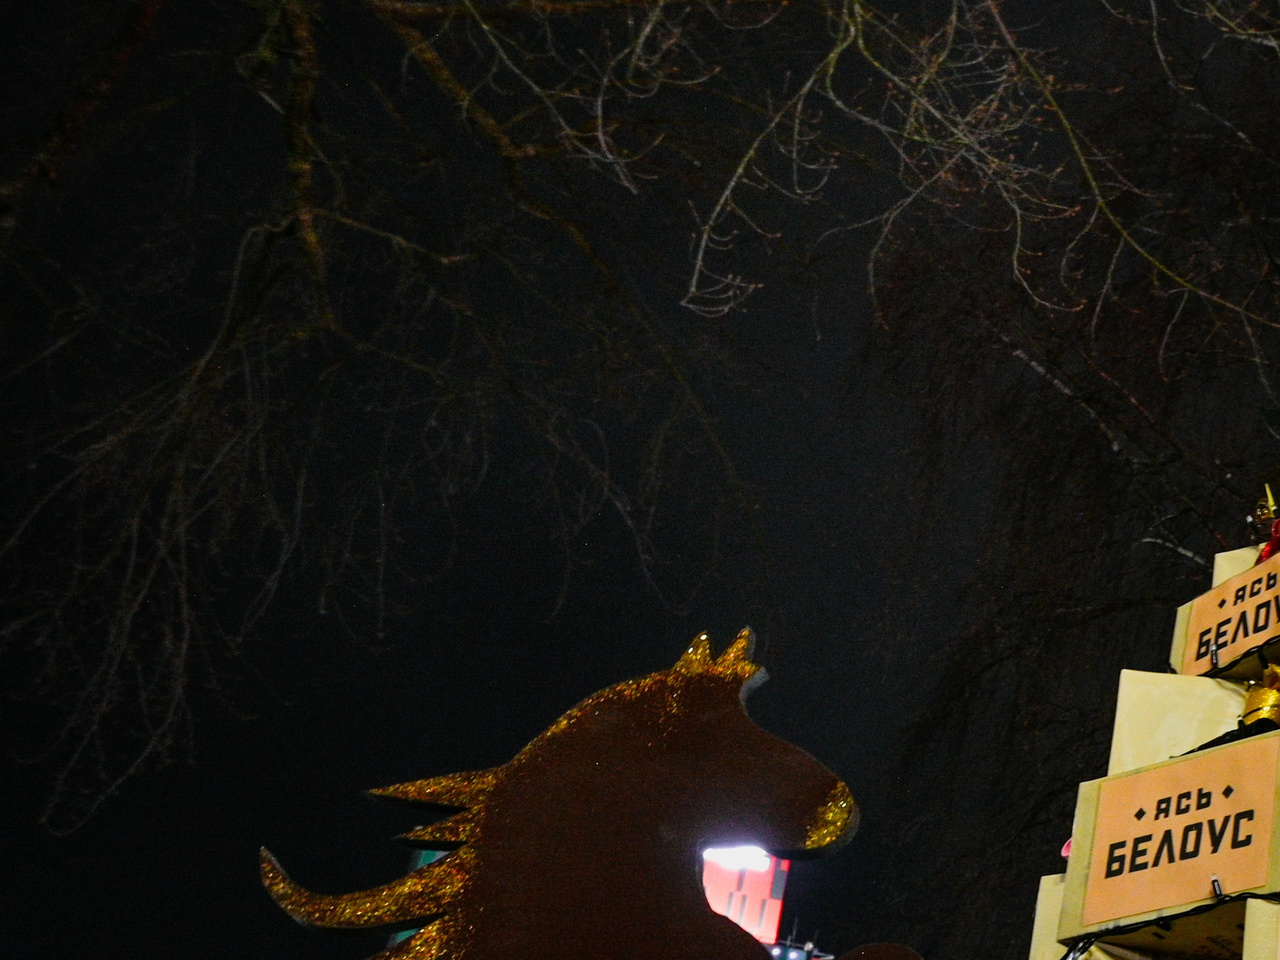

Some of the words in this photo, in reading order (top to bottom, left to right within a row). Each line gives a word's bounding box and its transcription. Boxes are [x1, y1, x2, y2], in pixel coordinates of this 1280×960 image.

[1232, 571, 1278, 606] ЯСЬ
[1154, 788, 1212, 821] ЯСЬ
[1105, 809, 1255, 879] БЕЛОУС
